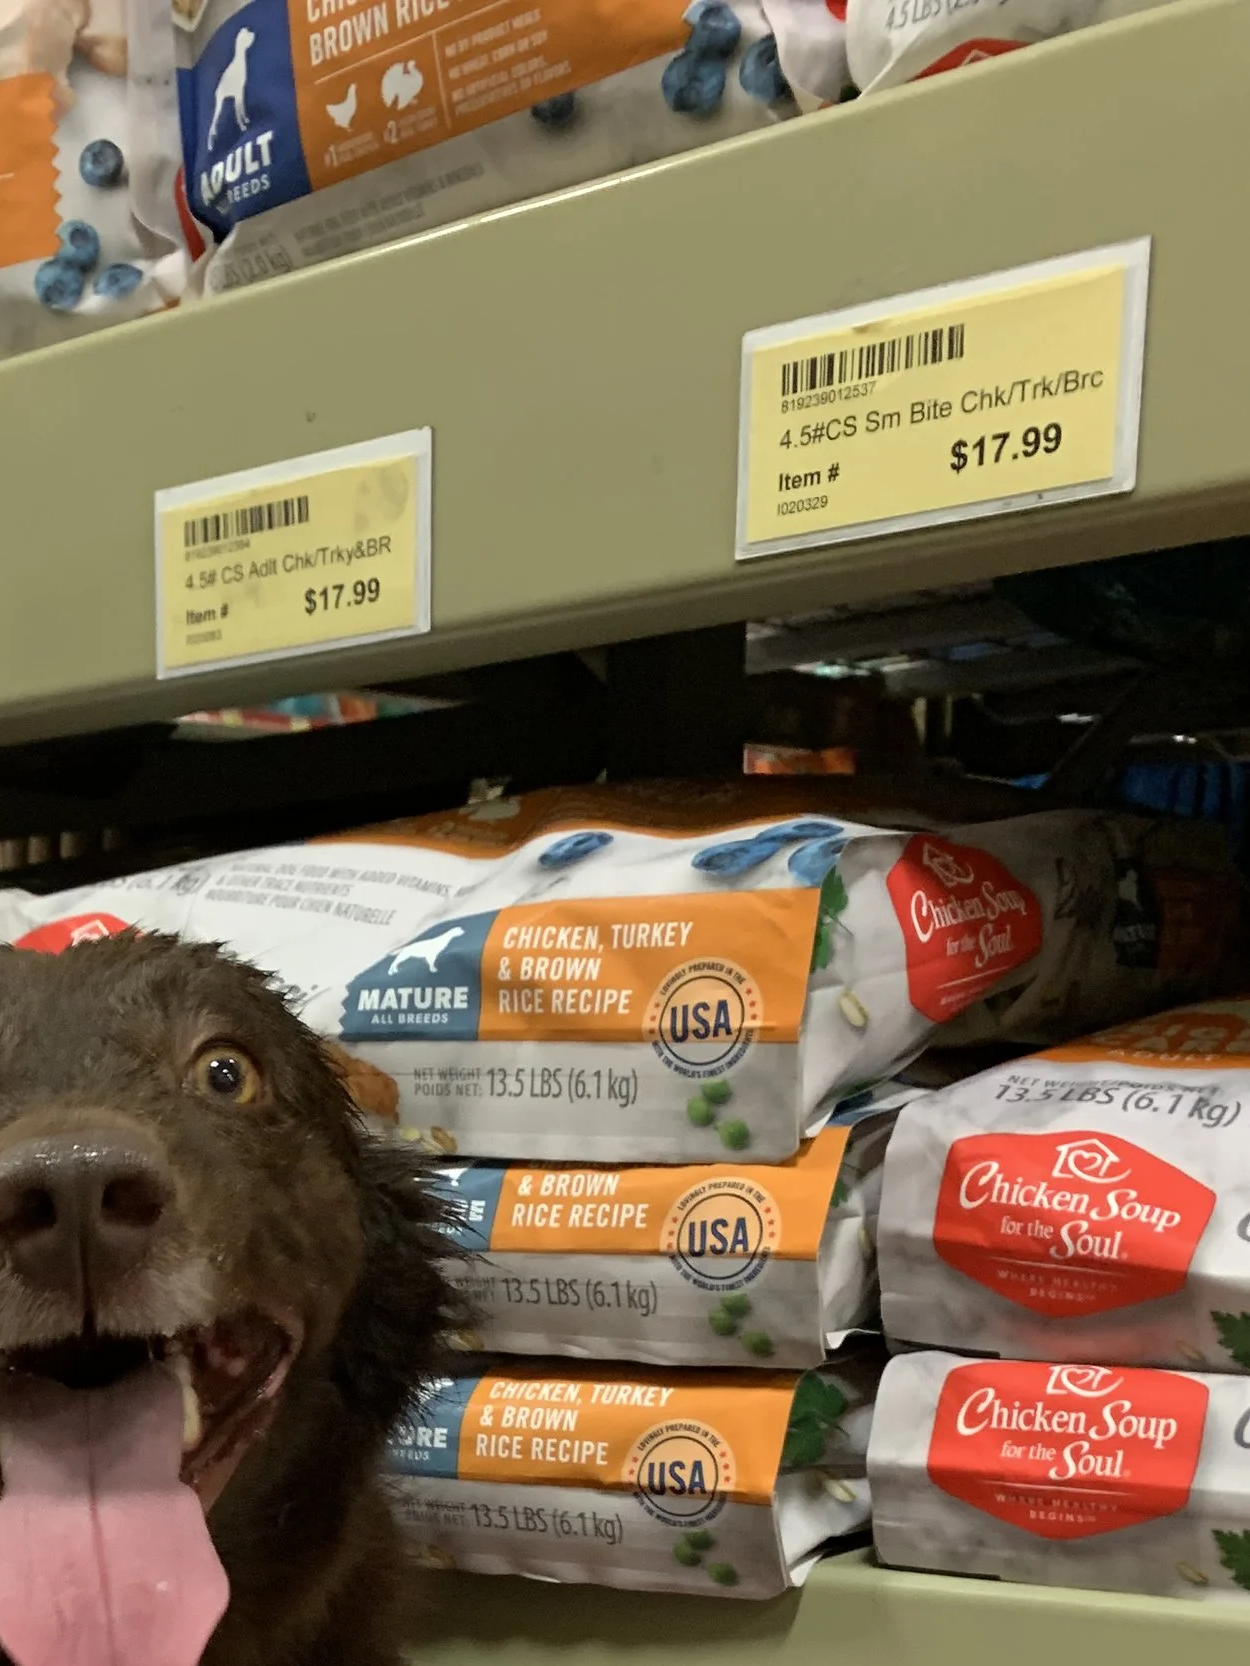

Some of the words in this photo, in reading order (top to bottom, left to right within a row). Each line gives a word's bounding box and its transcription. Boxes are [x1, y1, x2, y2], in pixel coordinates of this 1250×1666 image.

[310, 20, 391, 66] BROWN
[199, 130, 273, 205] ADULT
[779, 415, 857, 452] 4.5#CS
[865, 408, 902, 436] Sm
[910, 398, 953, 427] Bite
[960, 367, 1105, 414] Chk/Trk/Brc
[780, 380, 877, 415] 819239012537
[949, 421, 1063, 474] $17.99
[778, 471, 821, 492] Item
[827, 463, 840, 484] #
[221, 564, 244, 585] CS
[282, 535, 392, 574] Chk/Trky&BR
[304, 577, 381, 616] $17.99
[186, 608, 216, 625] Item
[910, 889, 985, 944] Chicken
[982, 881, 1028, 920] Soup
[502, 925, 604, 953] CHICKEN,
[610, 921, 693, 948] TURKEY
[975, 922, 1013, 969] Soul
[497, 958, 511, 982] &
[520, 957, 601, 982] BROWN
[357, 986, 468, 1011] MATURE
[497, 989, 544, 1015] RICE
[551, 988, 633, 1015] RECIPE
[371, 1013, 395, 1025] ALL
[397, 1012, 449, 1025] BREEDS
[670, 1000, 733, 1043] USA
[414, 1068, 435, 1082] NET
[488, 1068, 526, 1098] 13.5
[529, 1067, 564, 1099] LBS
[567, 1068, 603, 1103] (6.1
[605, 1069, 638, 1106] kg)
[1060, 1085, 1116, 1106] LBS
[1184, 1099, 1242, 1130] kg)
[518, 1174, 533, 1196] &
[539, 1173, 621, 1197] BROWN
[959, 1161, 1089, 1214] Chicken
[1089, 1187, 1182, 1234] Soup
[511, 1203, 561, 1228] RICE
[567, 1203, 650, 1229] RECIPE
[688, 1216, 750, 1258] USA
[1000, 1215, 1024, 1236] for
[1026, 1219, 1055, 1240] the
[1049, 1218, 1124, 1260] Soul
[501, 1275, 542, 1305] 13.5
[545, 1277, 581, 1306] LBS
[584, 1278, 622, 1310] (6.1
[624, 1280, 659, 1317] kg)
[488, 1381, 583, 1406] CHICKEN,
[588, 1382, 675, 1408] TURKEY
[479, 1406, 493, 1427] &
[500, 1406, 578, 1432] BROWN
[956, 1387, 1089, 1436] Chicken
[1088, 1400, 1179, 1450] Soup
[475, 1434, 522, 1460] RICE
[531, 1436, 609, 1466] RECIPE
[1000, 1440, 1025, 1459] for
[1028, 1443, 1057, 1461] the
[1048, 1440, 1124, 1481] Soul
[647, 1459, 708, 1496] USA
[470, 1504, 509, 1531] 13.5
[512, 1504, 549, 1534] LBS
[553, 1506, 589, 1539] (6.1
[591, 1510, 624, 1545] kg)
